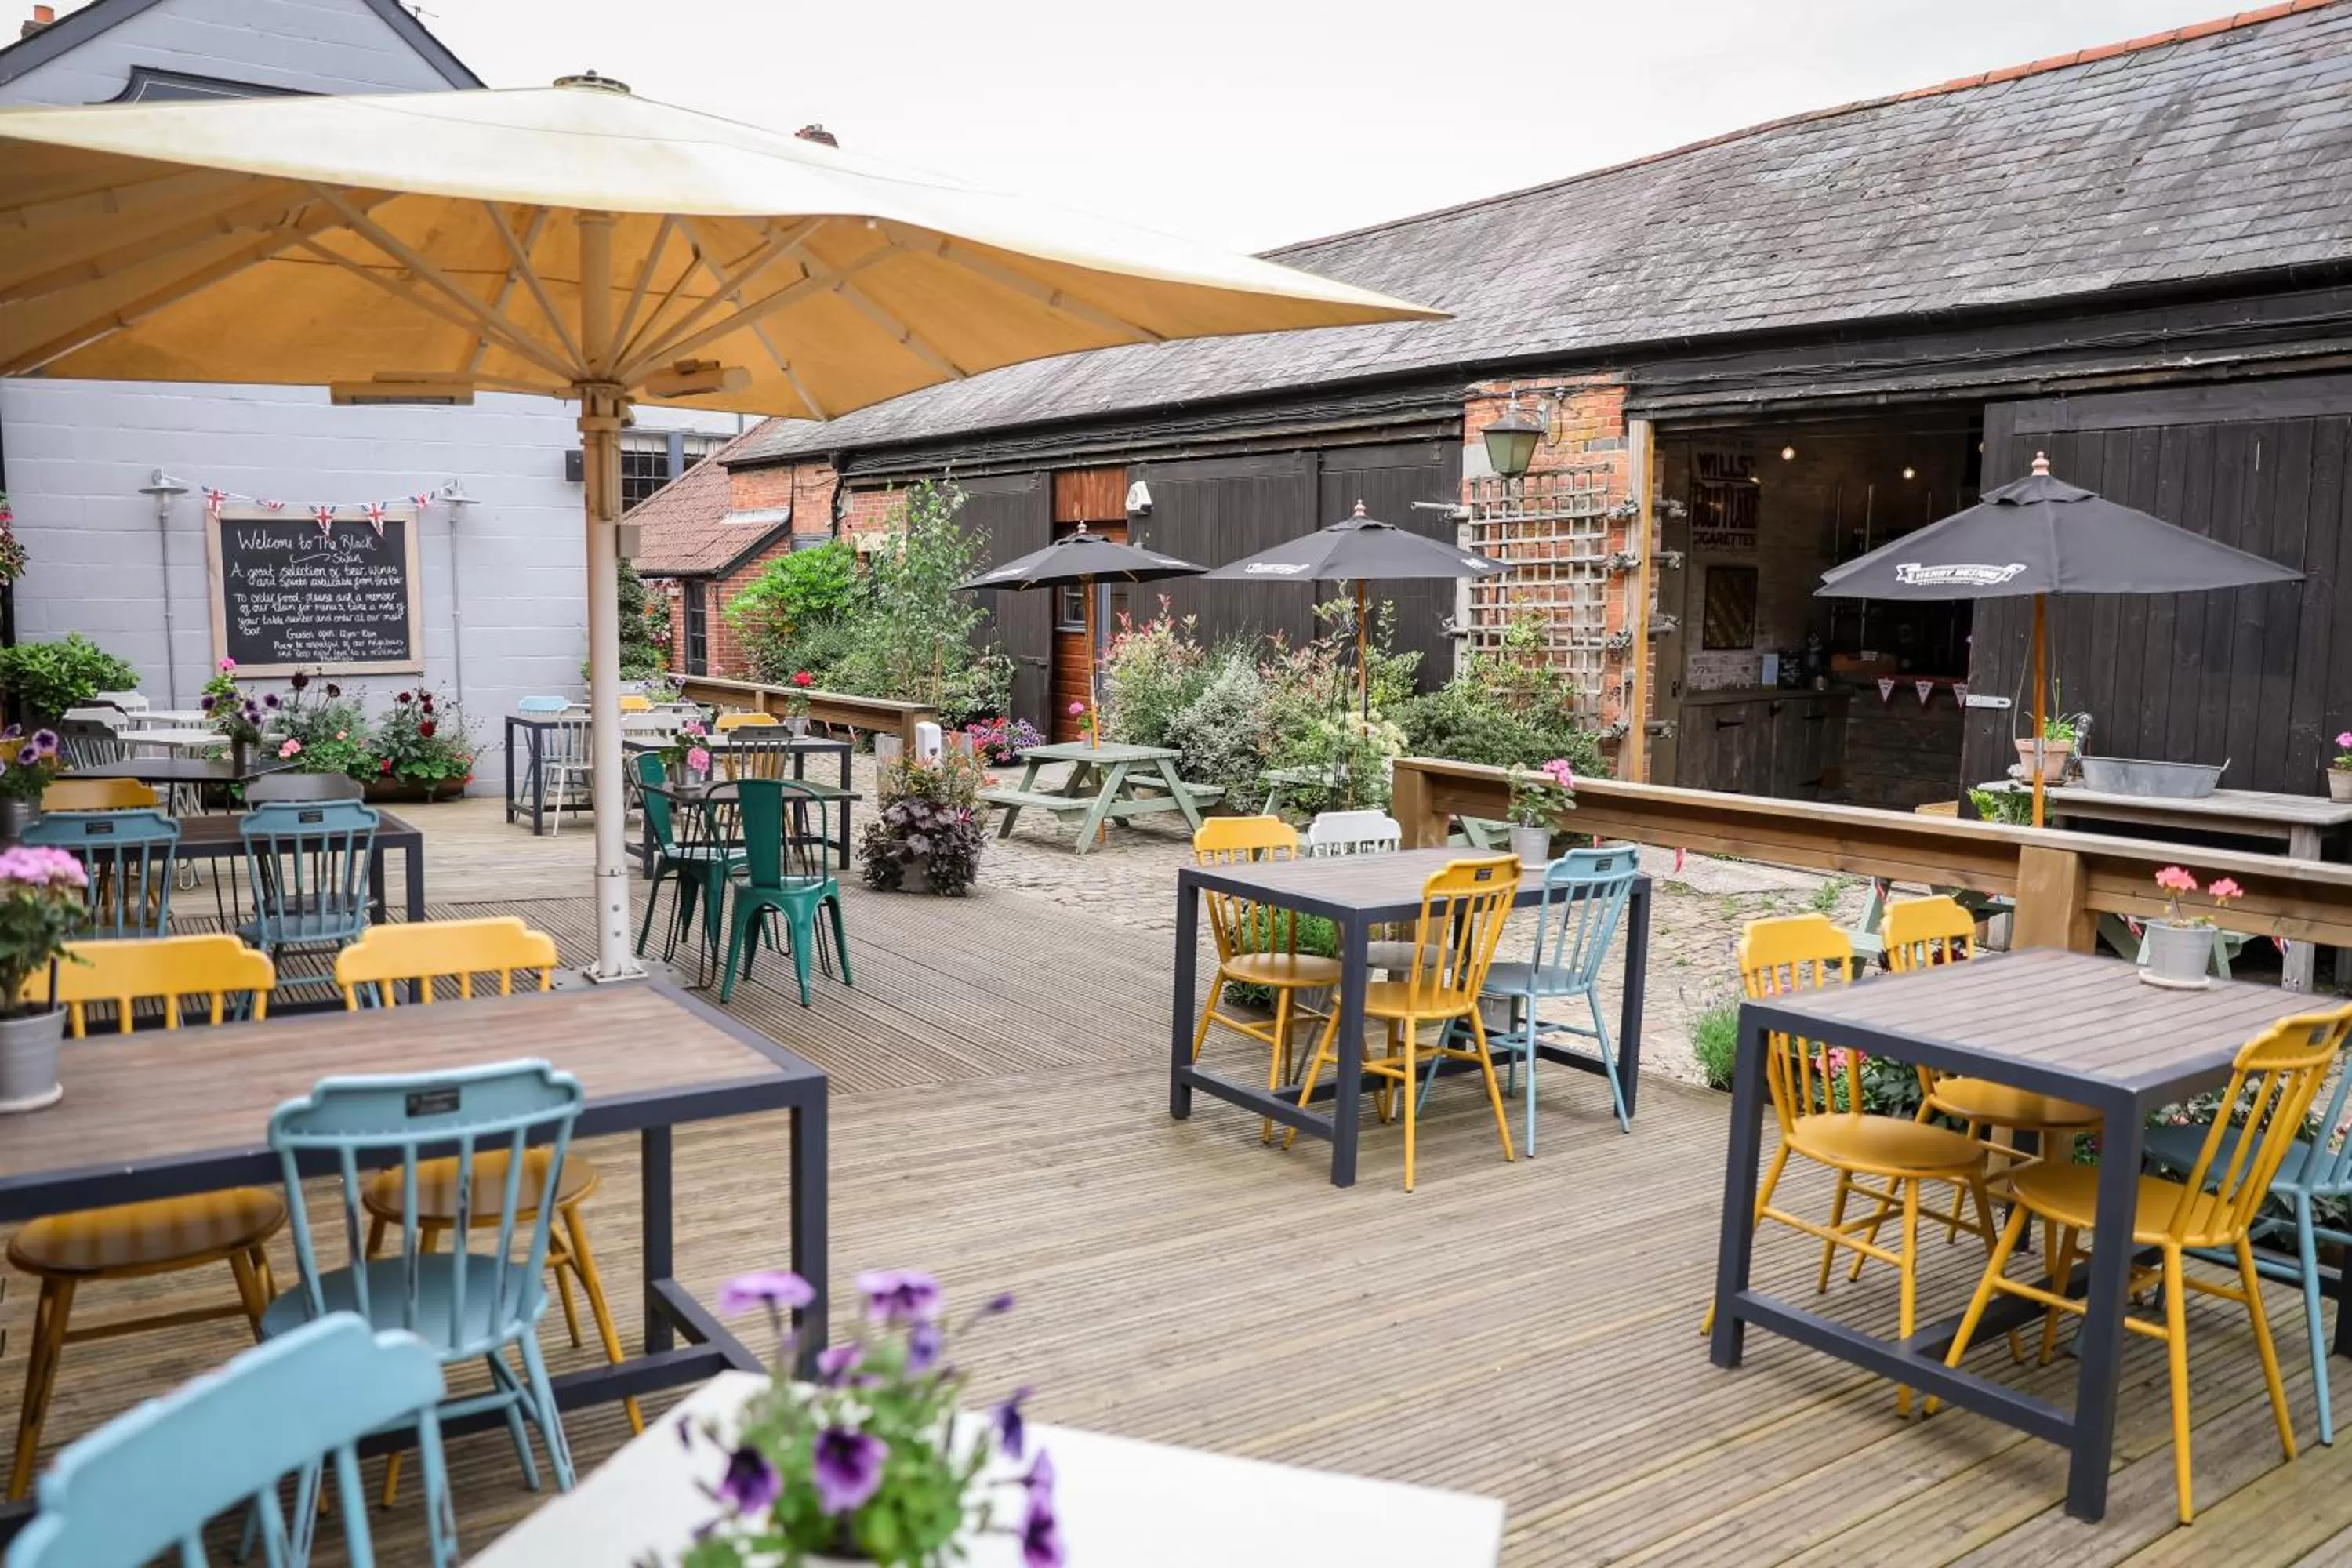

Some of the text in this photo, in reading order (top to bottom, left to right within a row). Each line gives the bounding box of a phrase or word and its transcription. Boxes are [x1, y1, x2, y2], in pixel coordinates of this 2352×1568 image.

[238, 528, 377, 556] Welcome to The Black
[332, 553, 365, 564] Swan
[230, 561, 245, 578] A
[247, 564, 274, 585] great
[279, 563, 327, 578] selection
[328, 566, 341, 579] of
[256, 576, 276, 587] and
[250, 592, 275, 603] order
[355, 593, 362, 603] a
[239, 604, 251, 617] of
[252, 604, 270, 612] our
[298, 603, 313, 618] for
[238, 617, 260, 630] your
